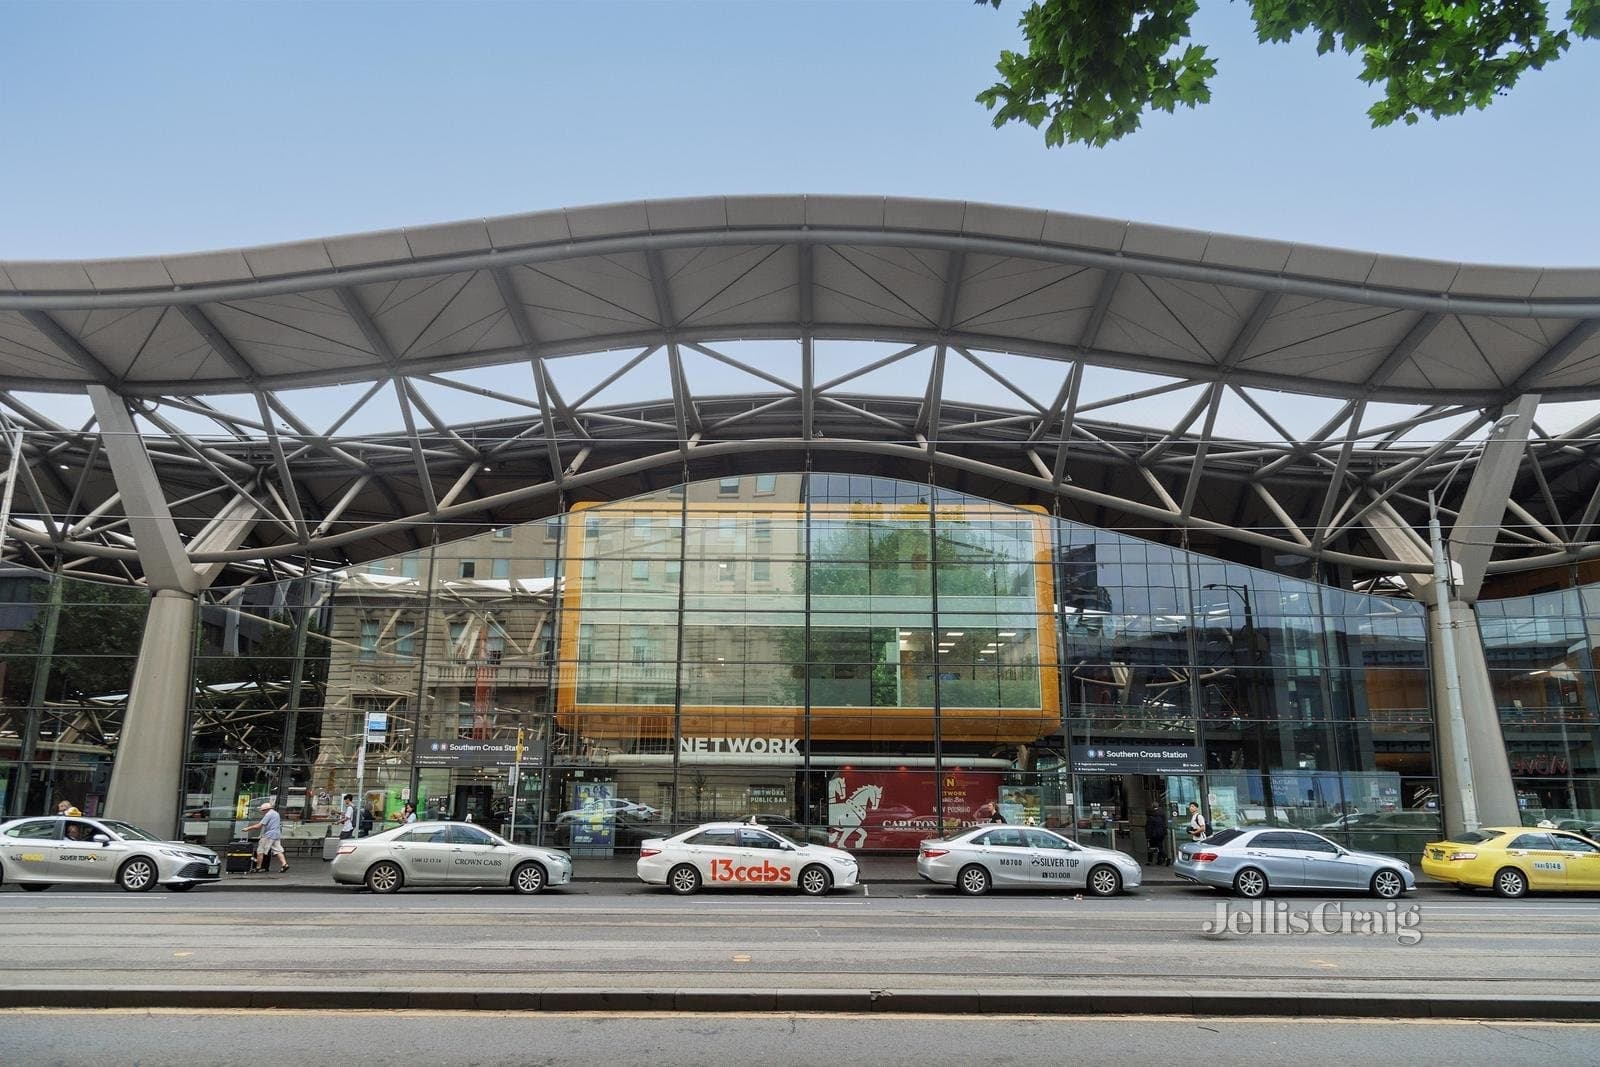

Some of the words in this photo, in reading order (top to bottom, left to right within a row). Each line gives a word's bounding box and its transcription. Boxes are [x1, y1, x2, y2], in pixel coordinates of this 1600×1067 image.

[680, 737, 800, 754] NETWORK
[946, 778, 955, 786] N
[1041, 858, 1064, 867] SILVER
[1066, 859, 1079, 867] TOP
[710, 860, 791, 881] 13cabs
